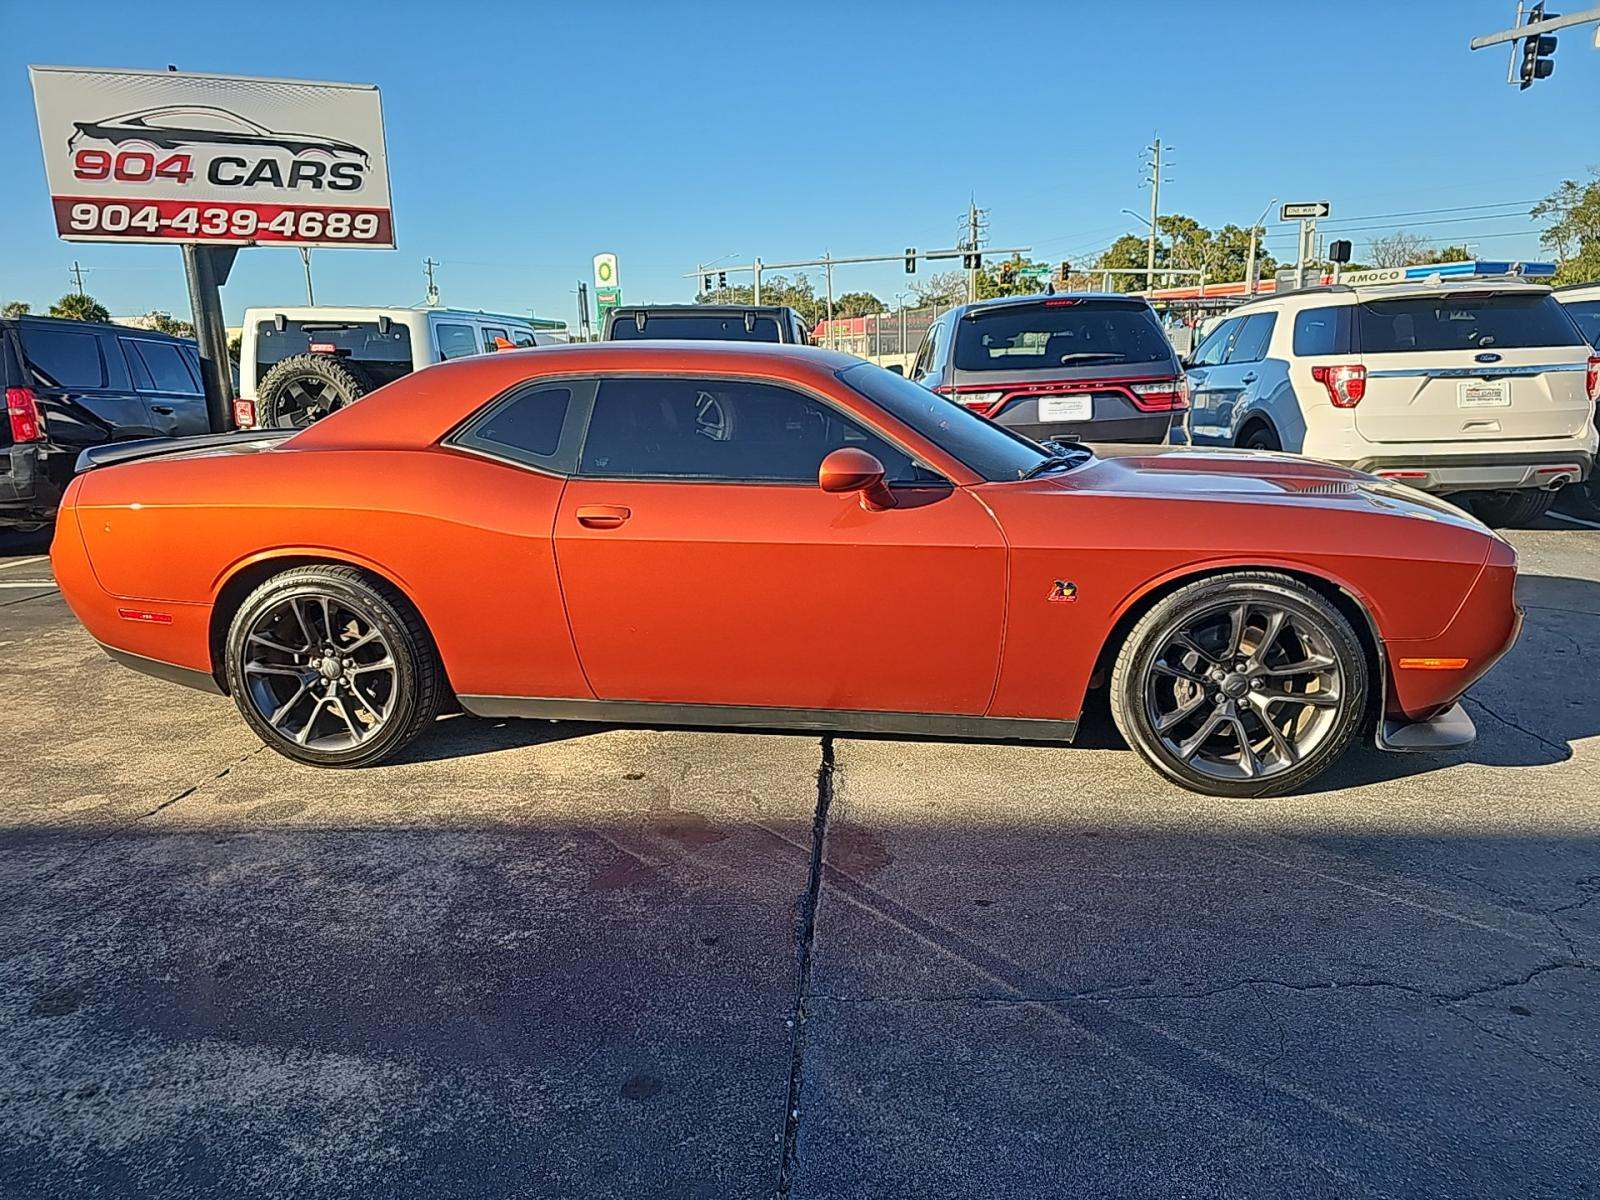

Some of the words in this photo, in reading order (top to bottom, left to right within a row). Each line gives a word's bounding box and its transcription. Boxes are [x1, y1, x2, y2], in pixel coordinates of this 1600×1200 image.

[73, 149, 194, 184] 904
[207, 156, 364, 190] CARS
[70, 202, 379, 239] 904-439-4689
[1347, 271, 1399, 283] AMOCO
